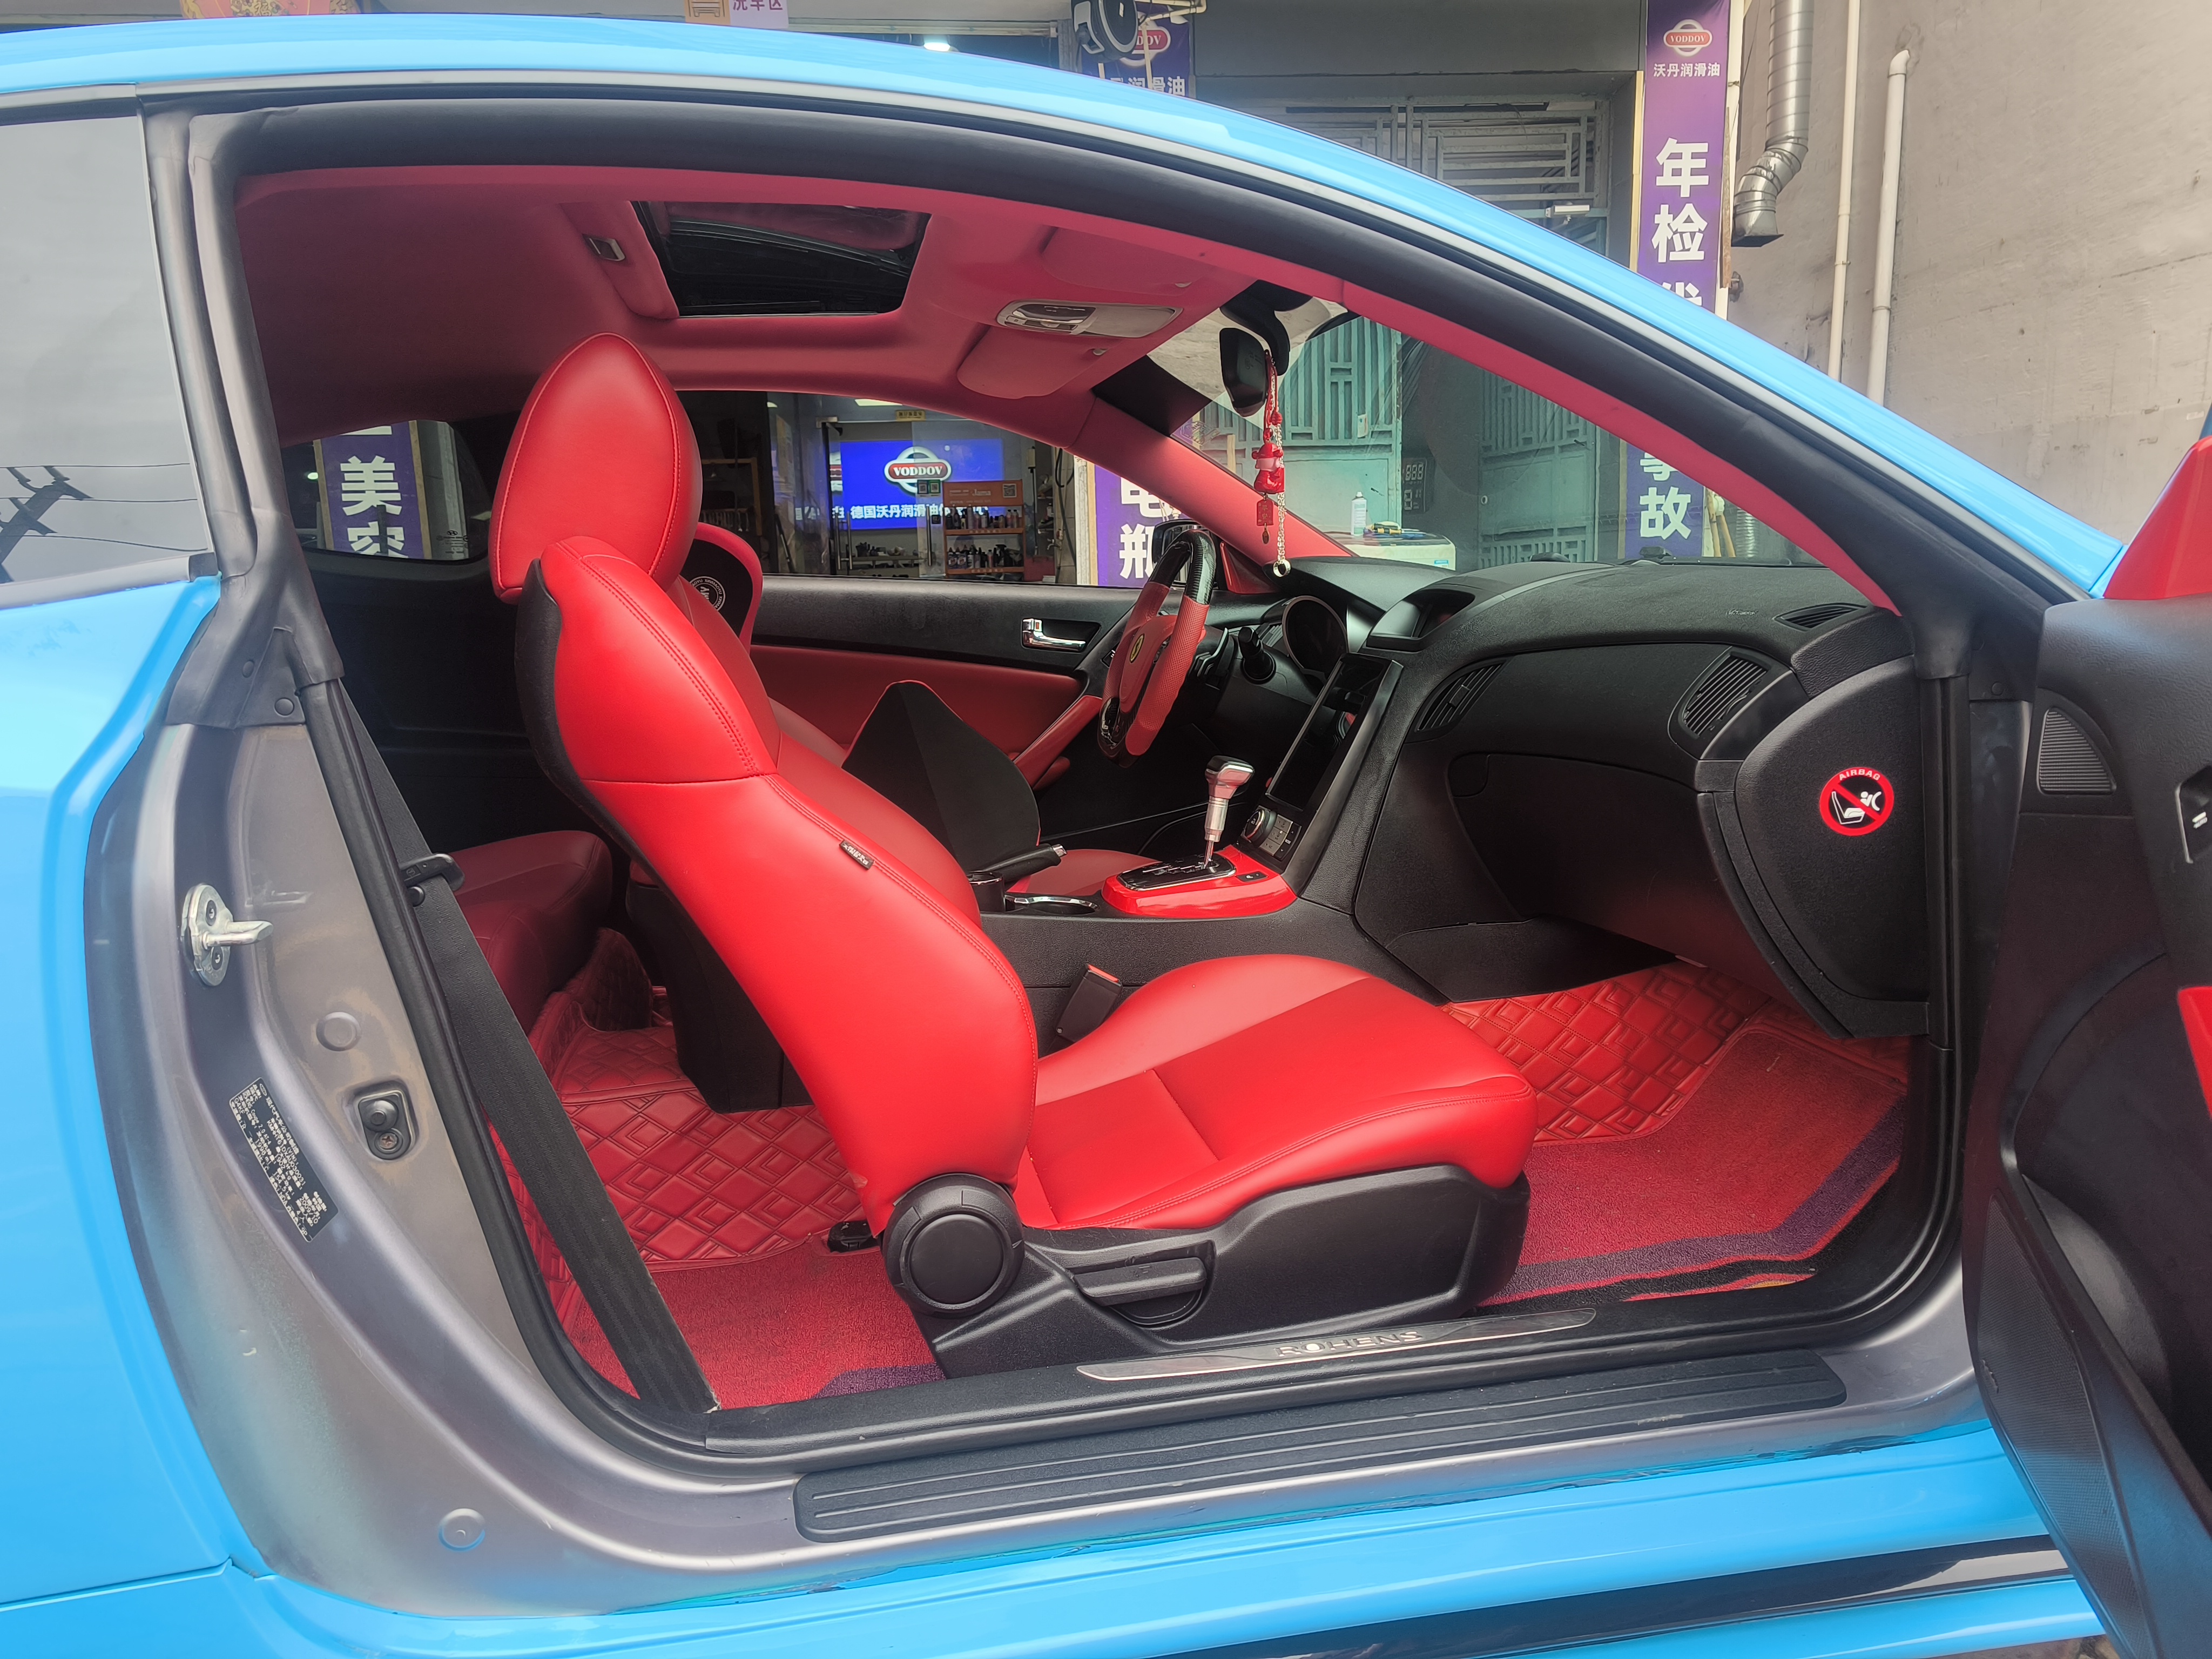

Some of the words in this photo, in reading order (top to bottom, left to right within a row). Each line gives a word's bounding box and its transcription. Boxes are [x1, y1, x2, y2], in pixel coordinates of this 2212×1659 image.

[1654, 62, 1720, 77] 沃丹润滑油
[893, 466, 943, 477] VODDOV
[1839, 769, 1880, 781] AIRBAG
[1273, 1331, 1422, 1357] ROHENS
